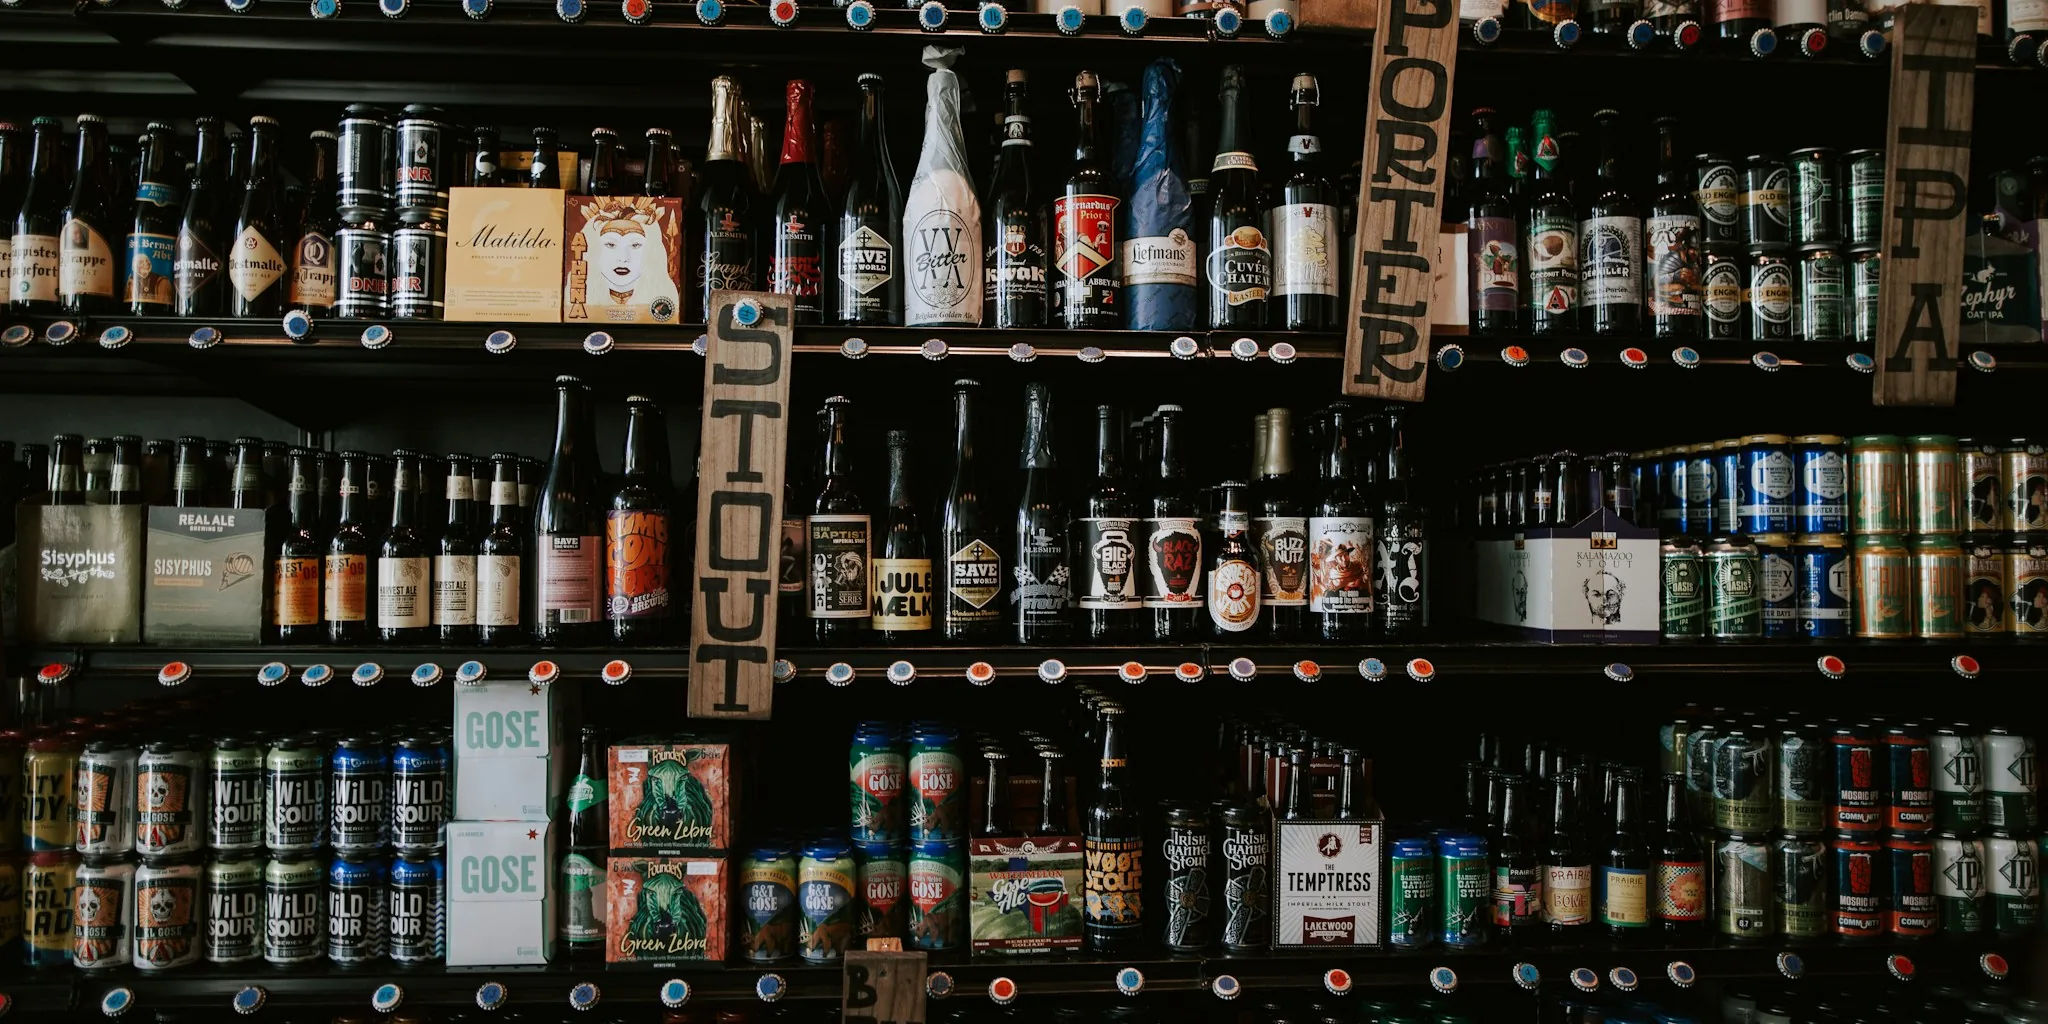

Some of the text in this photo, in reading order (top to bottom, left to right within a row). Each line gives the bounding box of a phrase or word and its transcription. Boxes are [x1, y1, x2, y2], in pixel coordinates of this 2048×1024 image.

[855, 10, 864, 21] 15
[1131, 13, 1142, 23] 17
[1354, 0, 1452, 384] PORTER
[1080, 210, 1102, 220] Prior
[1885, 54, 1976, 372] IPA
[709, 231, 748, 240] ALESMITH
[843, 249, 887, 264] SAVE
[915, 251, 968, 272] Bitter
[1131, 243, 1186, 265] Liefmans
[570, 232, 588, 319] ATHENA
[350, 277, 389, 294] DNR
[1088, 278, 1121, 289] ABBEY ALE
[1233, 289, 1265, 303] KASTEEL
[1961, 281, 2017, 311] Zephyr
[915, 313, 938, 321] Belgian
[939, 311, 964, 319] Golden
[1967, 311, 2004, 319] OAT IPA
[696, 303, 788, 712] STOUT
[179, 514, 235, 527] REAL ALE
[554, 537, 579, 545] SAVE
[813, 531, 866, 540] BAPTIST
[1163, 540, 1194, 553] BLACK
[1275, 537, 1304, 551] BUZZ
[41, 549, 116, 568] Sisyphus
[1102, 546, 1127, 561] BIG
[1275, 550, 1304, 564] NUTZ
[1577, 551, 1633, 560] KALAMAZOO
[154, 559, 212, 576] SISYPHUS
[1102, 561, 1126, 569] BLACK
[1164, 553, 1193, 571] RAZ
[1576, 560, 1633, 568] STOUT
[955, 563, 997, 577] SAVE
[456, 580, 467, 589] ALE
[974, 577, 997, 585] WORLD
[1673, 581, 1693, 592] OASIS
[1783, 570, 1793, 588] X
[1832, 571, 1844, 588] T
[406, 585, 418, 595] ALE
[634, 593, 651, 603] DEEP
[1776, 608, 1791, 617] DAYS
[466, 710, 540, 750] GOSE
[652, 748, 687, 767] Founders
[1953, 756, 1982, 786] IPA
[919, 773, 953, 791] GOSE
[1841, 790, 1869, 800] MOSAIC
[153, 812, 176, 823] GOSE
[277, 804, 324, 824] SOUR
[335, 803, 383, 824] SOUR
[396, 804, 443, 824] SOUR
[1839, 812, 1879, 823] COMMUNITY
[627, 816, 713, 842] Green Zebra
[461, 855, 537, 894] GOSE
[613, 863, 619, 873] 6
[647, 861, 682, 880] Founders
[1325, 863, 1335, 871] THE
[2008, 859, 2038, 889] IPA
[26, 871, 55, 887] THE
[988, 870, 1063, 880] WATERMELON
[1085, 870, 1142, 891] STOUT
[1288, 872, 1371, 892] TEMPTRESS
[1551, 869, 1591, 882] PRAIRIE
[1610, 875, 1643, 884] PRAIRIE
[1956, 860, 1984, 891] IPA
[751, 885, 775, 898] G&T
[808, 883, 831, 897] G&T
[867, 882, 900, 899] GOSE
[911, 881, 943, 899] GOSE
[992, 878, 1029, 901] Gose
[749, 896, 778, 911] GOSE
[805, 895, 834, 911] GOSE
[1000, 891, 1027, 914] Ale
[1839, 895, 1868, 906] MOSAIC
[208, 917, 256, 937] SOUR
[268, 917, 316, 937] SOUR
[1305, 921, 1354, 931] LAKEWOOD
[1838, 917, 1879, 928] COMMUNITY
[158, 925, 182, 936] GOSE
[620, 931, 707, 955] Green Zebra
